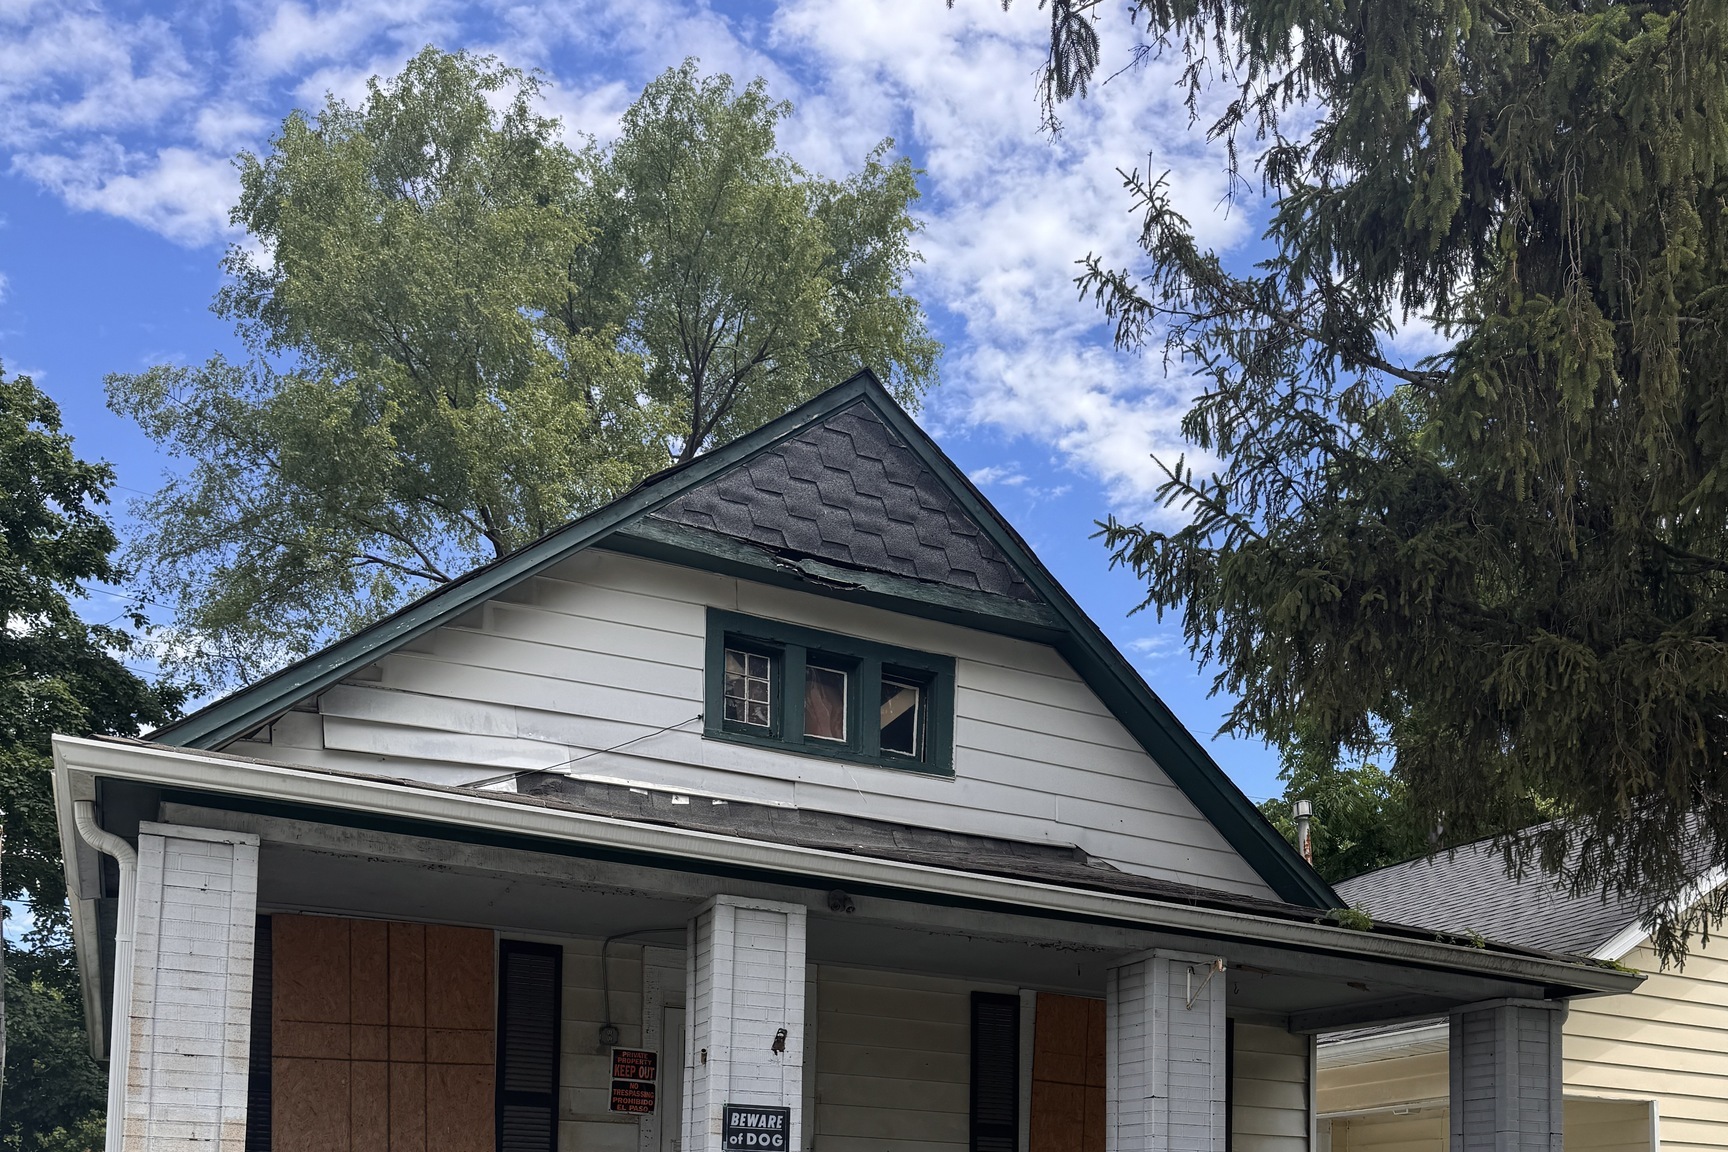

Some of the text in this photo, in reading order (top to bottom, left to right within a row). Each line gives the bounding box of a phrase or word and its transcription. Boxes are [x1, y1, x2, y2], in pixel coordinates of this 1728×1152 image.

[622, 1051, 649, 1060] PRIVATE
[617, 1057, 652, 1065] PROPERTY
[614, 1064, 655, 1079] KEEP OUT
[613, 1089, 654, 1099] TRESPASSING
[612, 1097, 654, 1106] PROHIBIDO
[730, 1112, 784, 1129] BEWARE
[729, 1132, 783, 1147] of DOG
